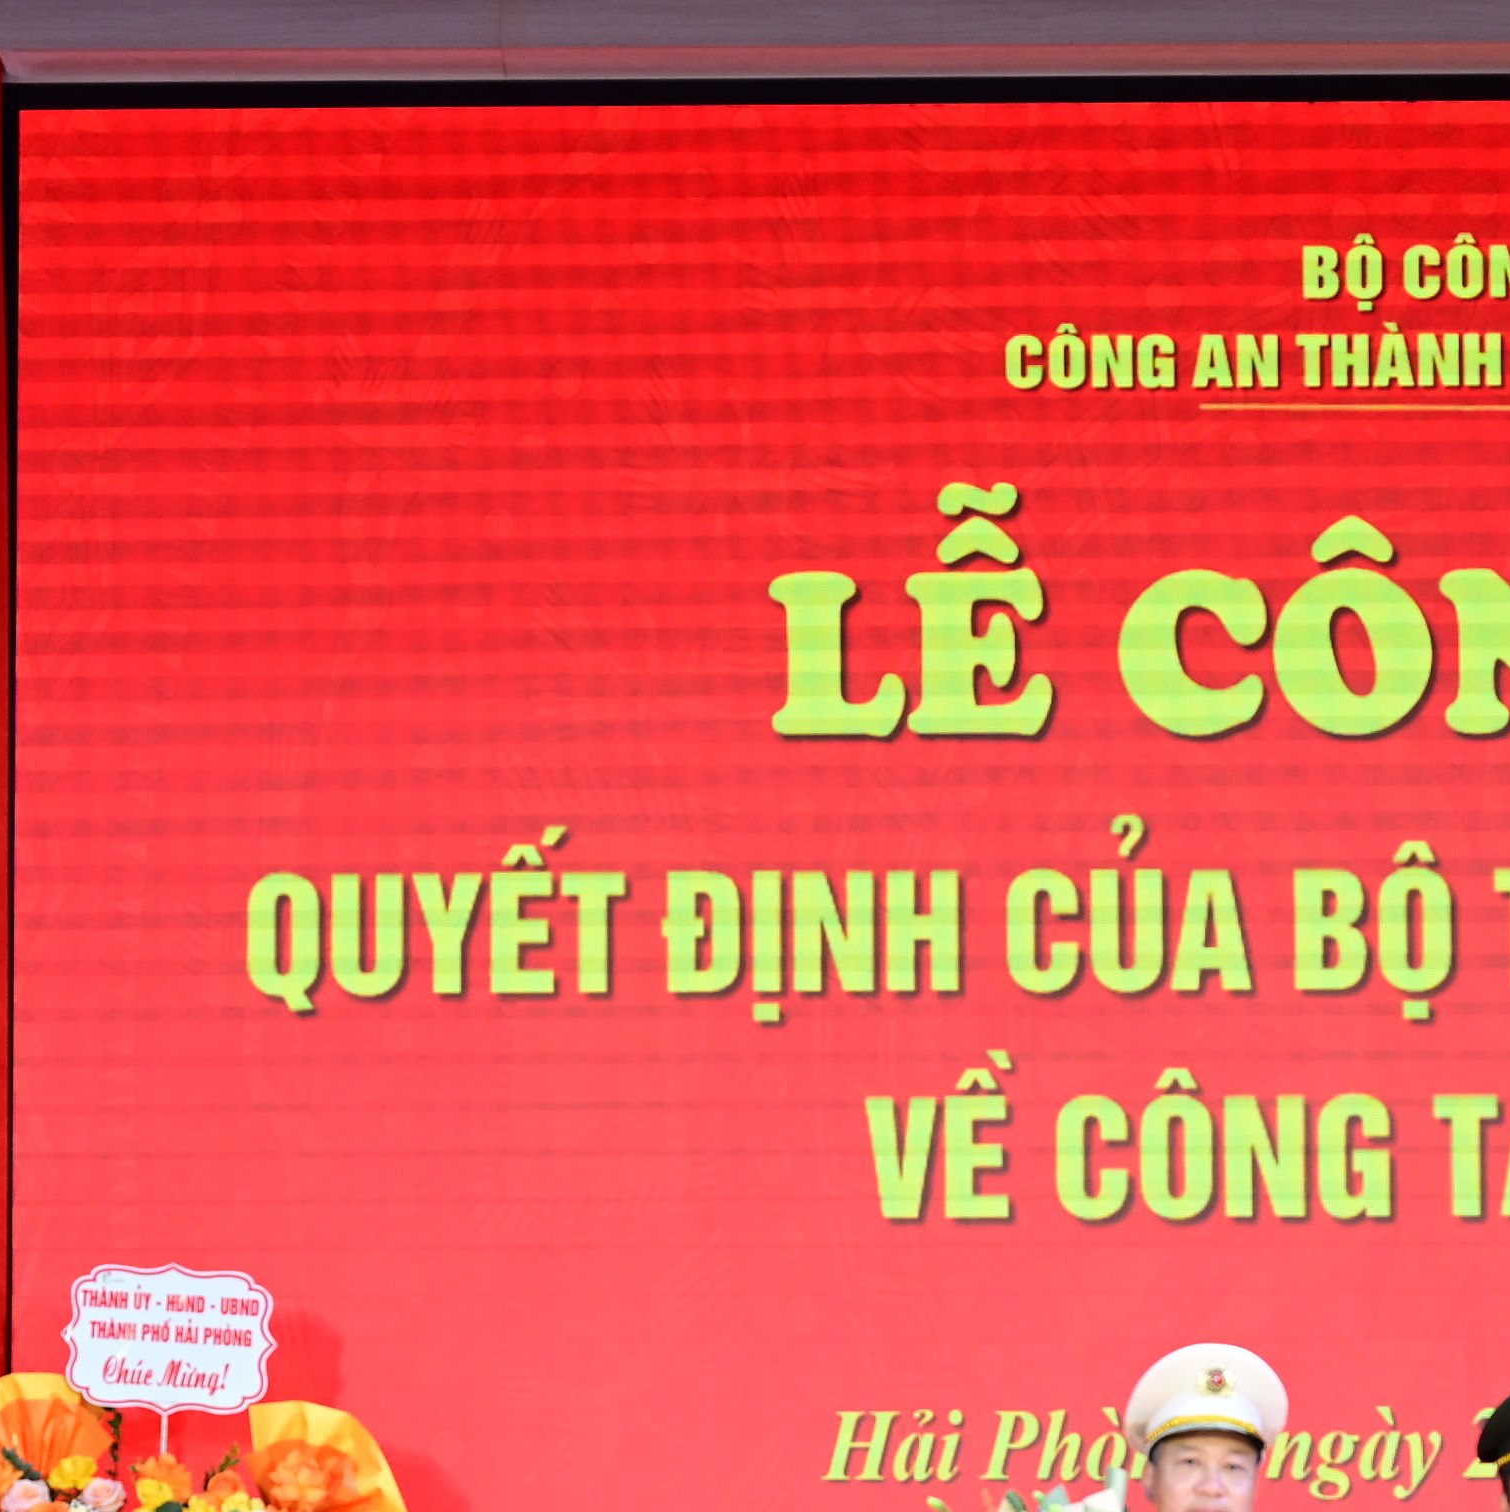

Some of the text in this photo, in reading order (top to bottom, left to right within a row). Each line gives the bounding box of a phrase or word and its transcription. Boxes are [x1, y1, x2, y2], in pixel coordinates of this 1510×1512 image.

[1302, 233, 1383, 311] BỘ
[1005, 323, 1175, 389] CÔNG
[1192, 334, 1279, 388] AN
[1295, 322, 1502, 387] THÀNH
[769, 483, 1053, 737] LỄ
[246, 825, 626, 1012] QUYẾT
[660, 869, 960, 1022] ĐỊNH
[1006, 813, 1252, 994] CỦA
[1293, 840, 1452, 1020] BỘ
[864, 1049, 1012, 1219] VỀ
[1055, 1067, 1391, 1221] CÔNG
[81, 1286, 128, 1309] THÀNH
[133, 1285, 152, 1310] ỦY
[221, 1297, 259, 1317] UBND
[90, 1317, 253, 1347] THÀNH PHỐ HẢI PHÒNG
[103, 1354, 230, 1396] Chúc Mừng!
[821, 1408, 964, 1481] Hải
[1265, 1405, 1442, 1500] ngày
